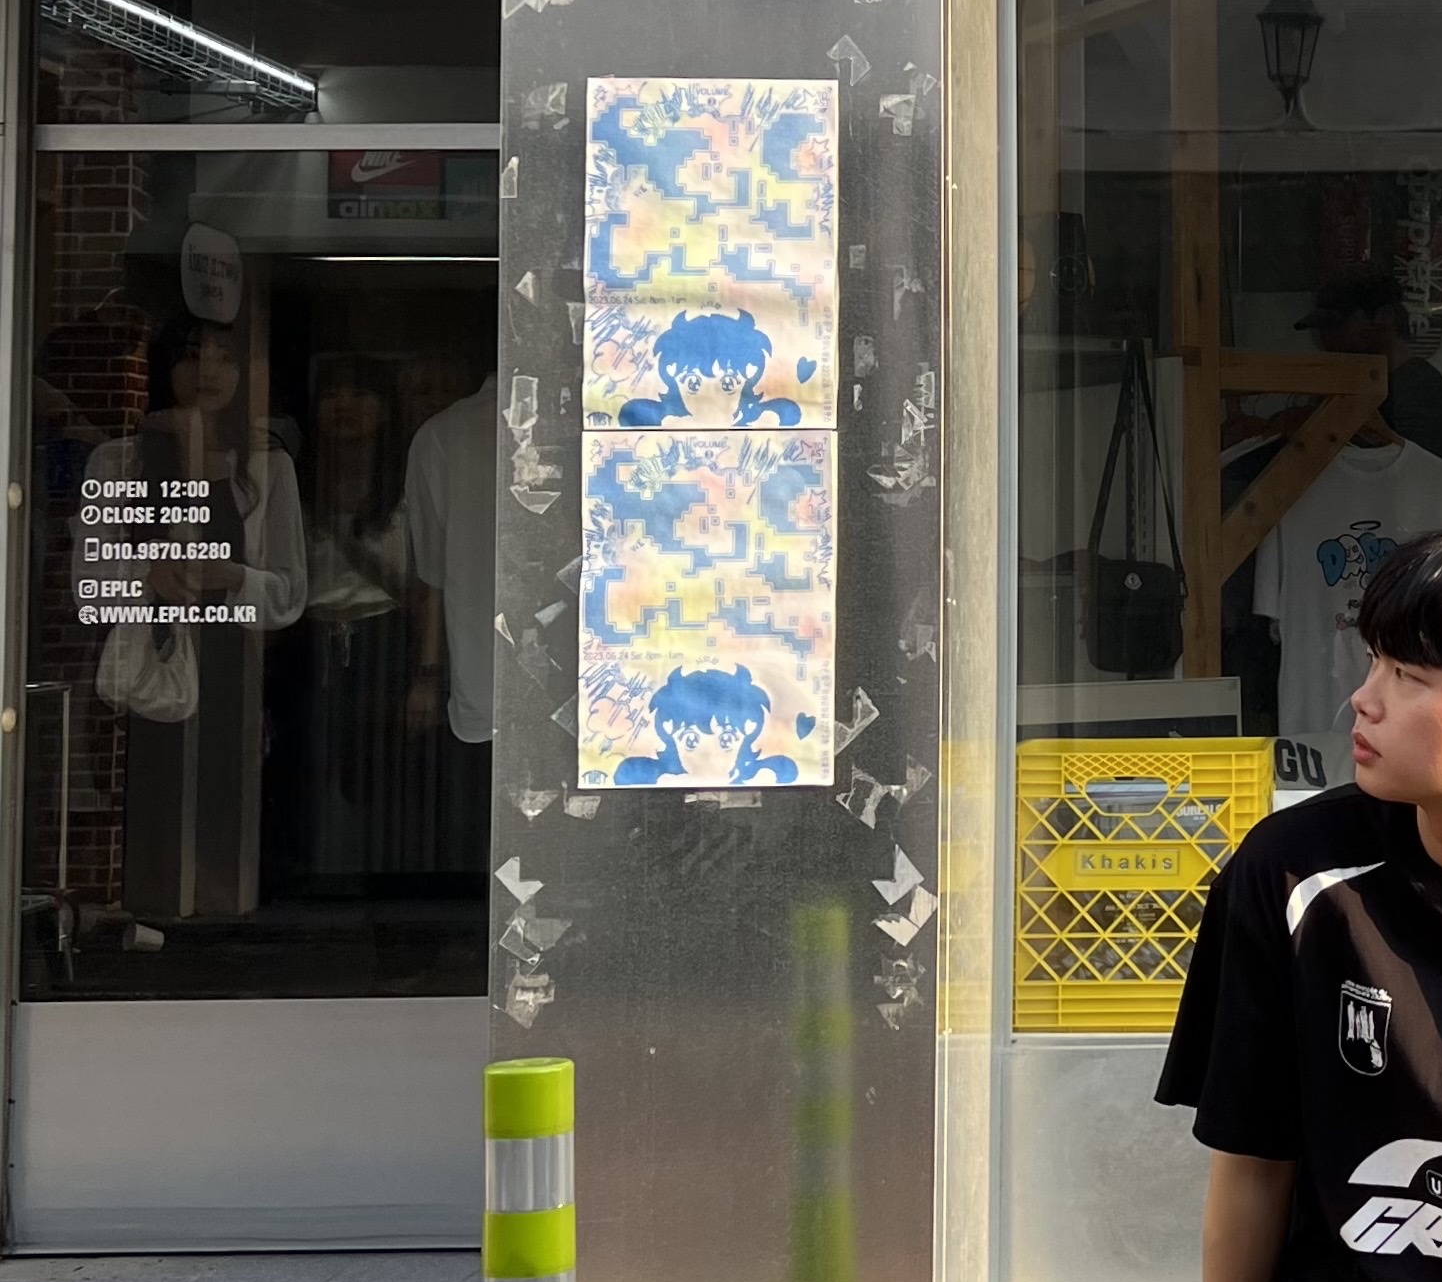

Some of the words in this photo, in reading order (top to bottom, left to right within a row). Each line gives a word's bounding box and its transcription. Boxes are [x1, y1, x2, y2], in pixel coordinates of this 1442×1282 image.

[103, 480, 149, 498] OPEN
[160, 480, 210, 498] 12:00
[102, 506, 155, 524] CLOSE
[159, 506, 210, 524] 20:00
[101, 542, 231, 560] 010.9870.6280
[101, 580, 143, 598] EPLC
[100, 605, 257, 623] WWW.EPLC.CO.KR
[1081, 853, 1174, 871] Khakis
